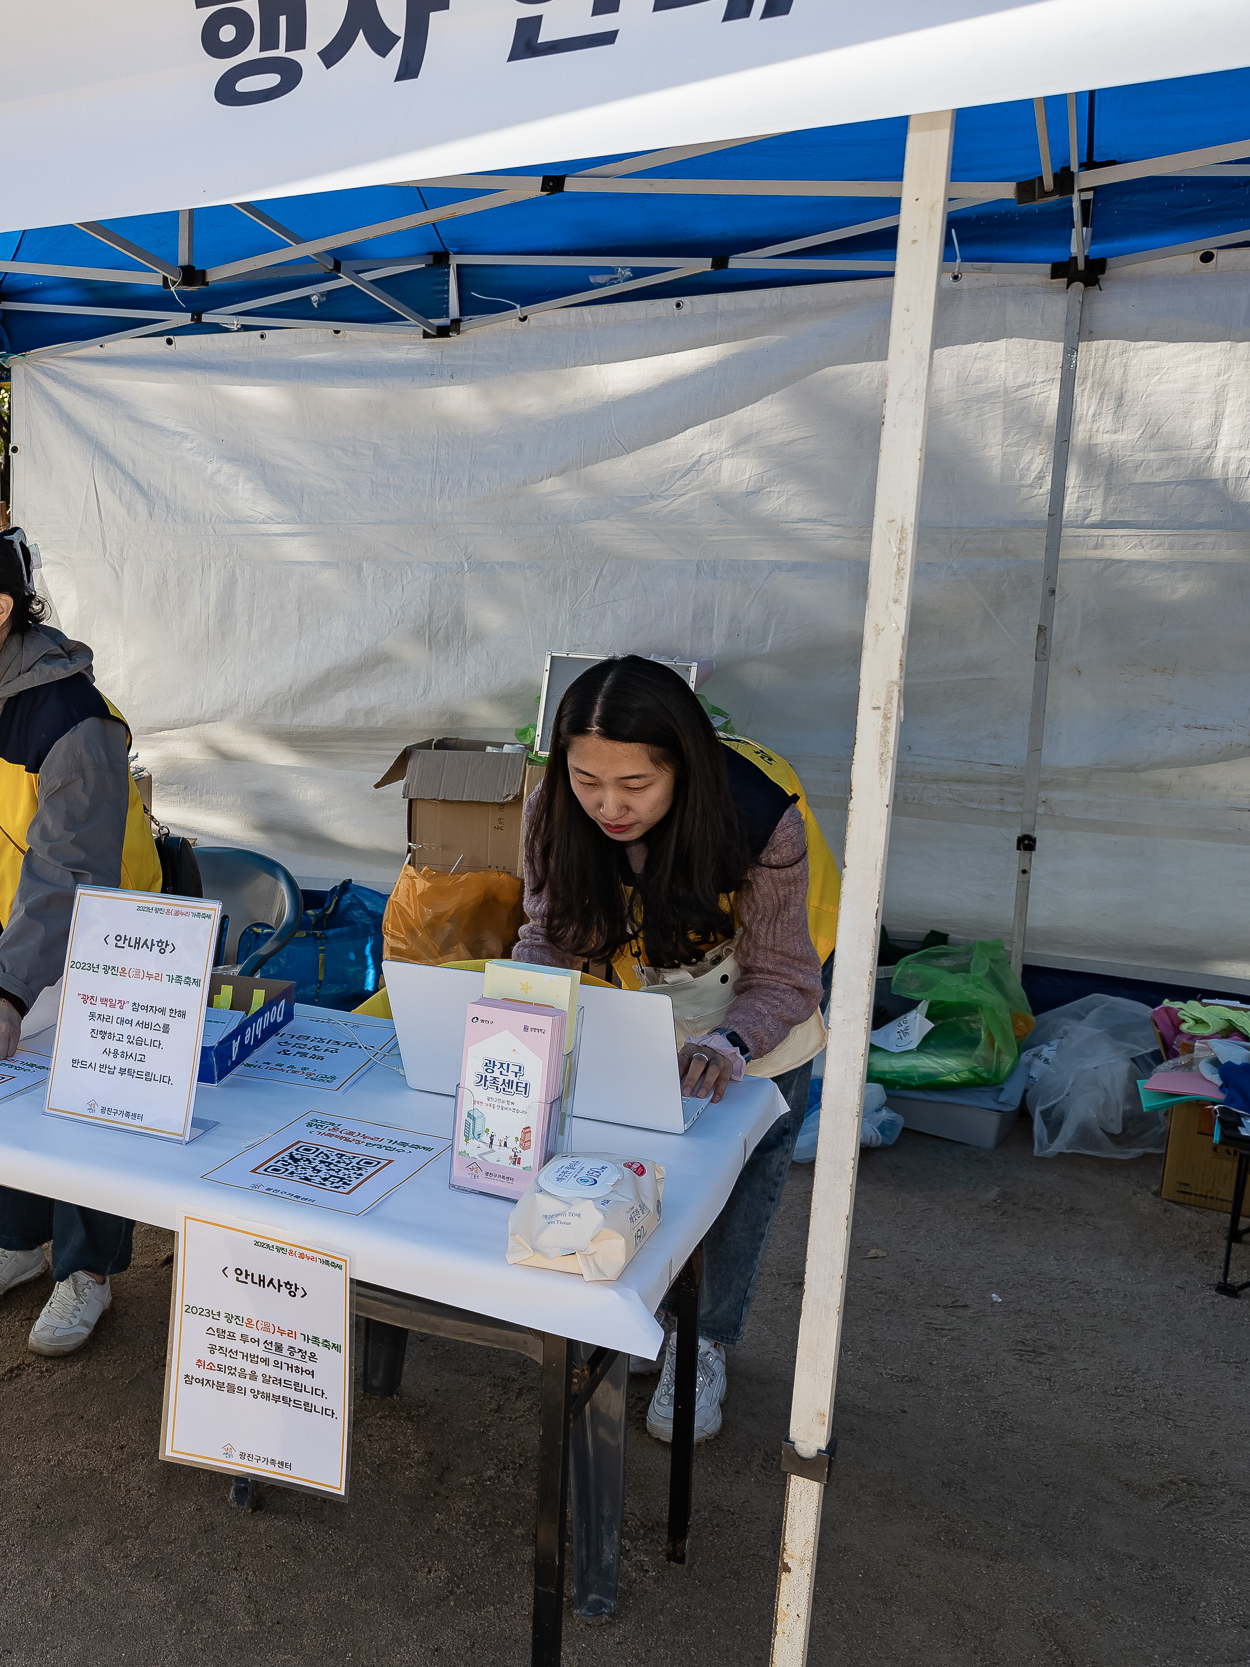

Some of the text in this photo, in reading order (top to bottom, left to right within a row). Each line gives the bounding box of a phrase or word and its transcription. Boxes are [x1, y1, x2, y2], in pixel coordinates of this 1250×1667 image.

[70, 960, 100, 974] 2023년
[166, 974, 201, 988] 가족축제
[88, 1011, 170, 1034] 돗자리 대여 서비스를
[131, 1002, 166, 1016] 참여자에
[168, 1008, 186, 1020] 한해
[245, 999, 286, 1046] Double
[90, 1028, 164, 1050] 진행하고 있습니다.
[102, 1048, 146, 1063] 사용하시고
[483, 1058, 524, 1078] 광진구
[71, 1058, 173, 1086] 반드시 반납 부탁드립니다.
[475, 1073, 529, 1096] 가족센터
[100, 1106, 144, 1122] 광진구가족센터
[253, 1240, 275, 1252] 2023년
[275, 1245, 288, 1255] 광진
[318, 1257, 343, 1271] 가족축제
[184, 1305, 221, 1321] 2023년
[300, 1332, 342, 1354] 가족축제
[206, 1326, 318, 1363] 스탬프 투어 선물 증정은
[207, 1344, 315, 1379] 공직선거법에 의거하여
[196, 1359, 328, 1399] 취소되었음을 알려드립니다.
[184, 1374, 338, 1420] 참여자분들의 양해부탁드립니다.
[239, 1451, 292, 1471] 광진구가족센터
